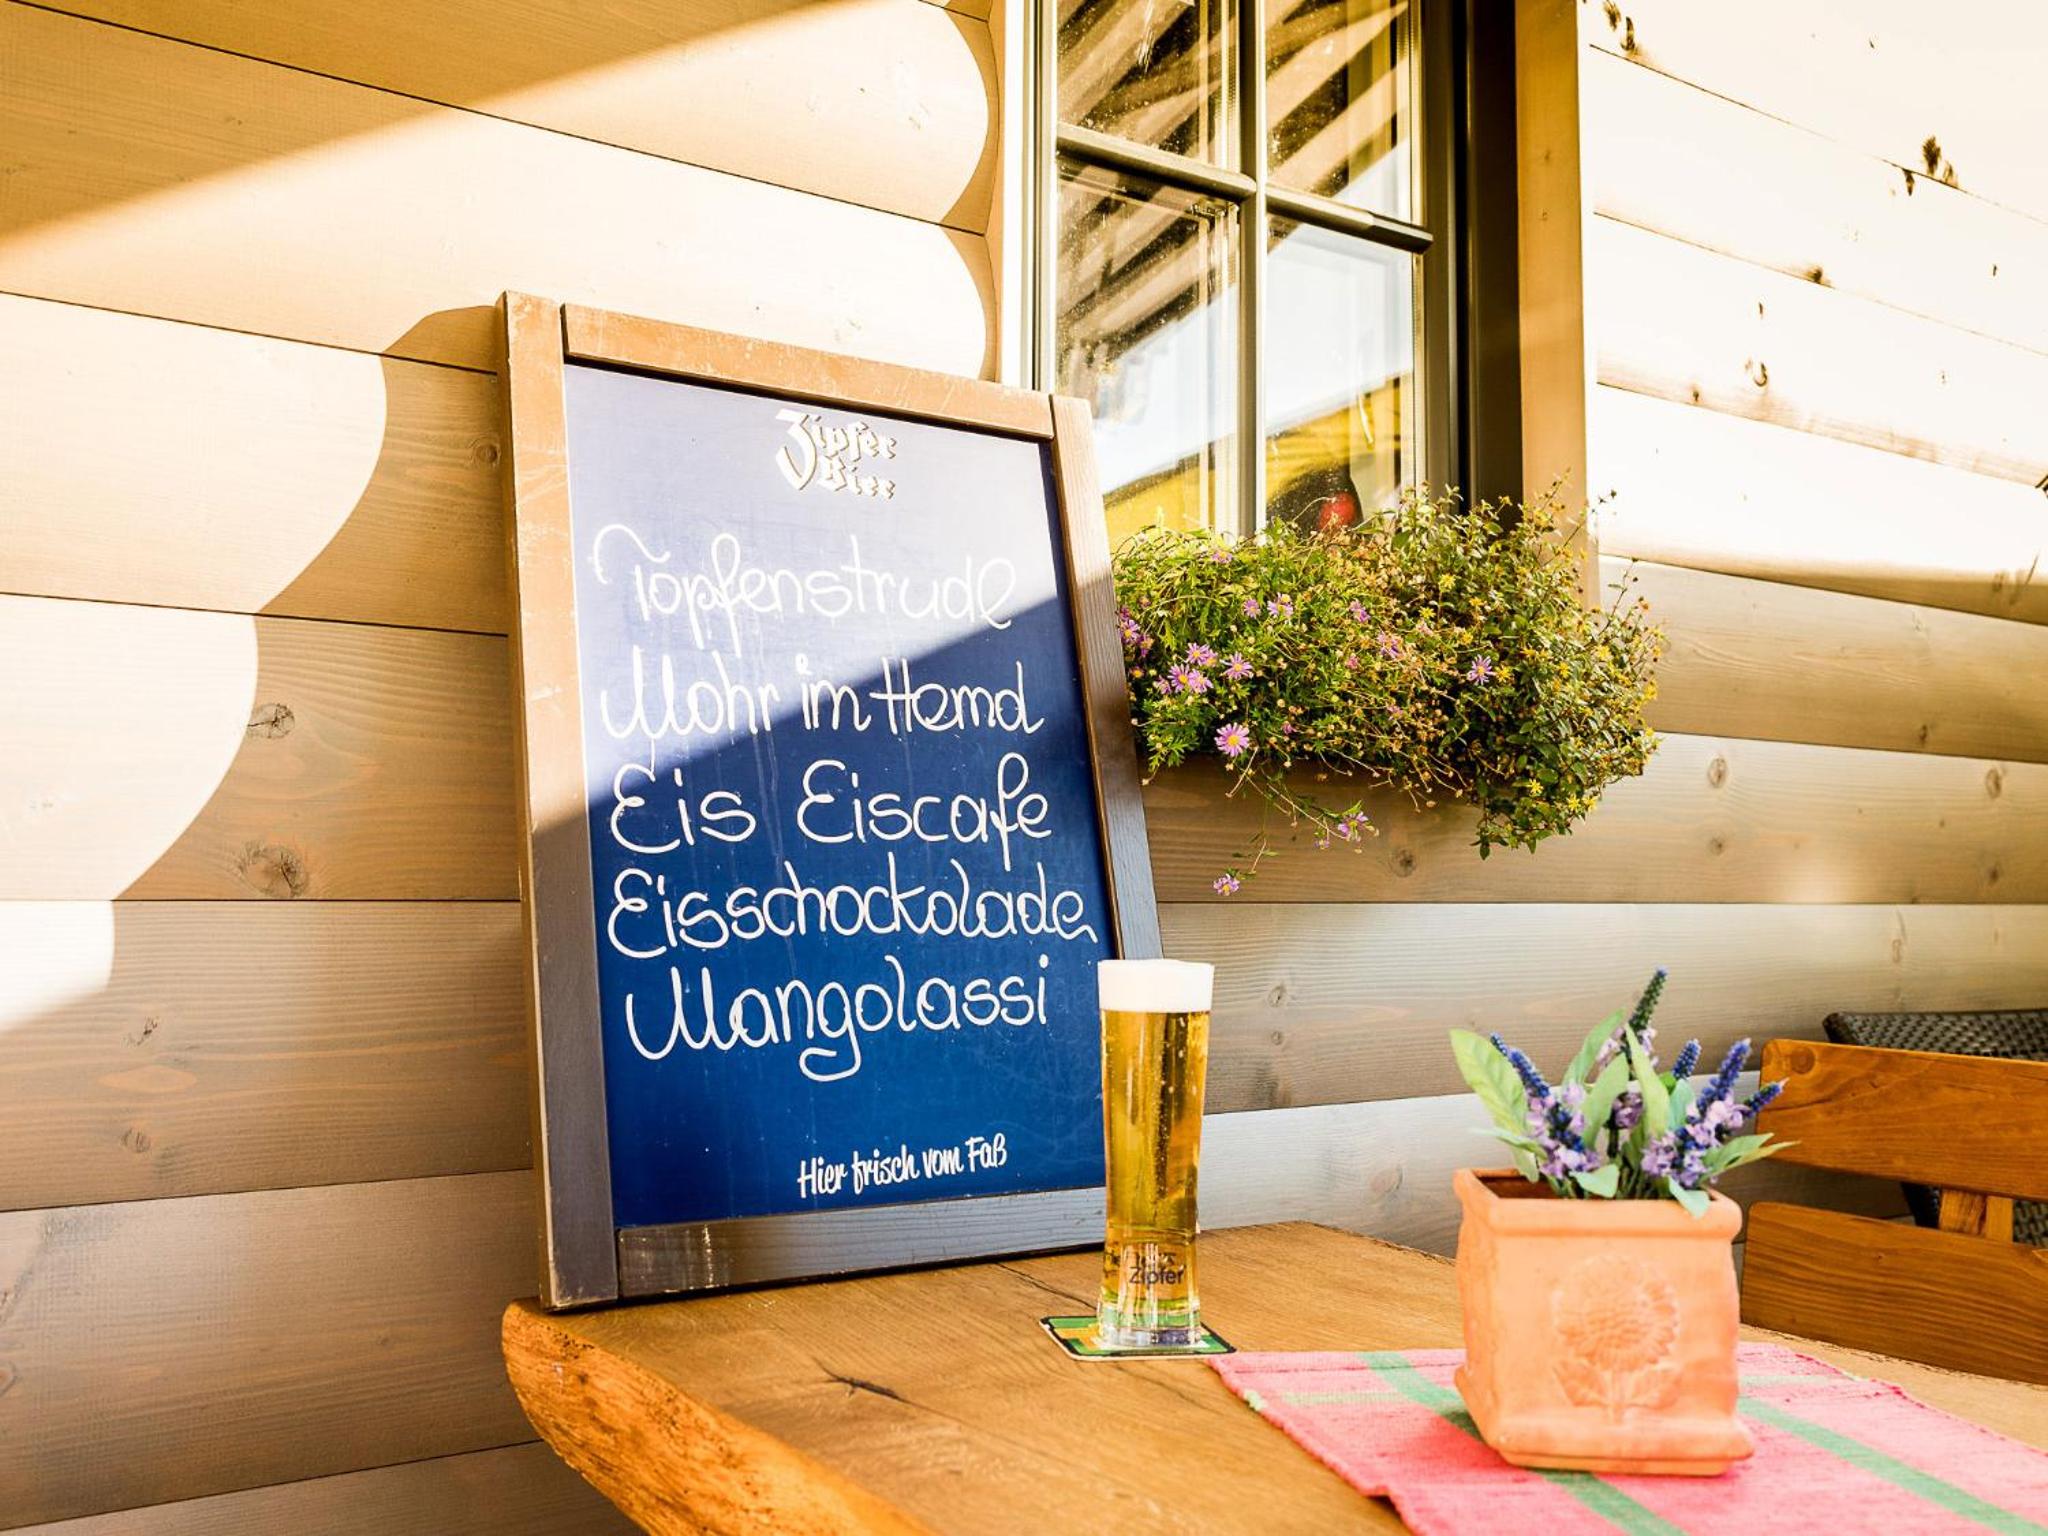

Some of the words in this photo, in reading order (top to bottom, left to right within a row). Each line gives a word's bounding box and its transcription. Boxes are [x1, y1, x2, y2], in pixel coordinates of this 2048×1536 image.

[775, 408, 897, 490] Zipfer
[600, 645, 782, 740] Mohr
[795, 653, 872, 732] im
[870, 656, 1045, 735] Hemd
[609, 762, 757, 854] Eis
[796, 752, 1052, 872] Eiscafe
[607, 851, 1098, 959] Eisschockolade
[625, 954, 1050, 1082] Mangolassi
[797, 1156, 848, 1199] Hier
[851, 1144, 920, 1195] frisch
[922, 1146, 965, 1179] vom
[965, 1132, 1008, 1173] Faß
[1129, 1264, 1186, 1290] Zipfer
